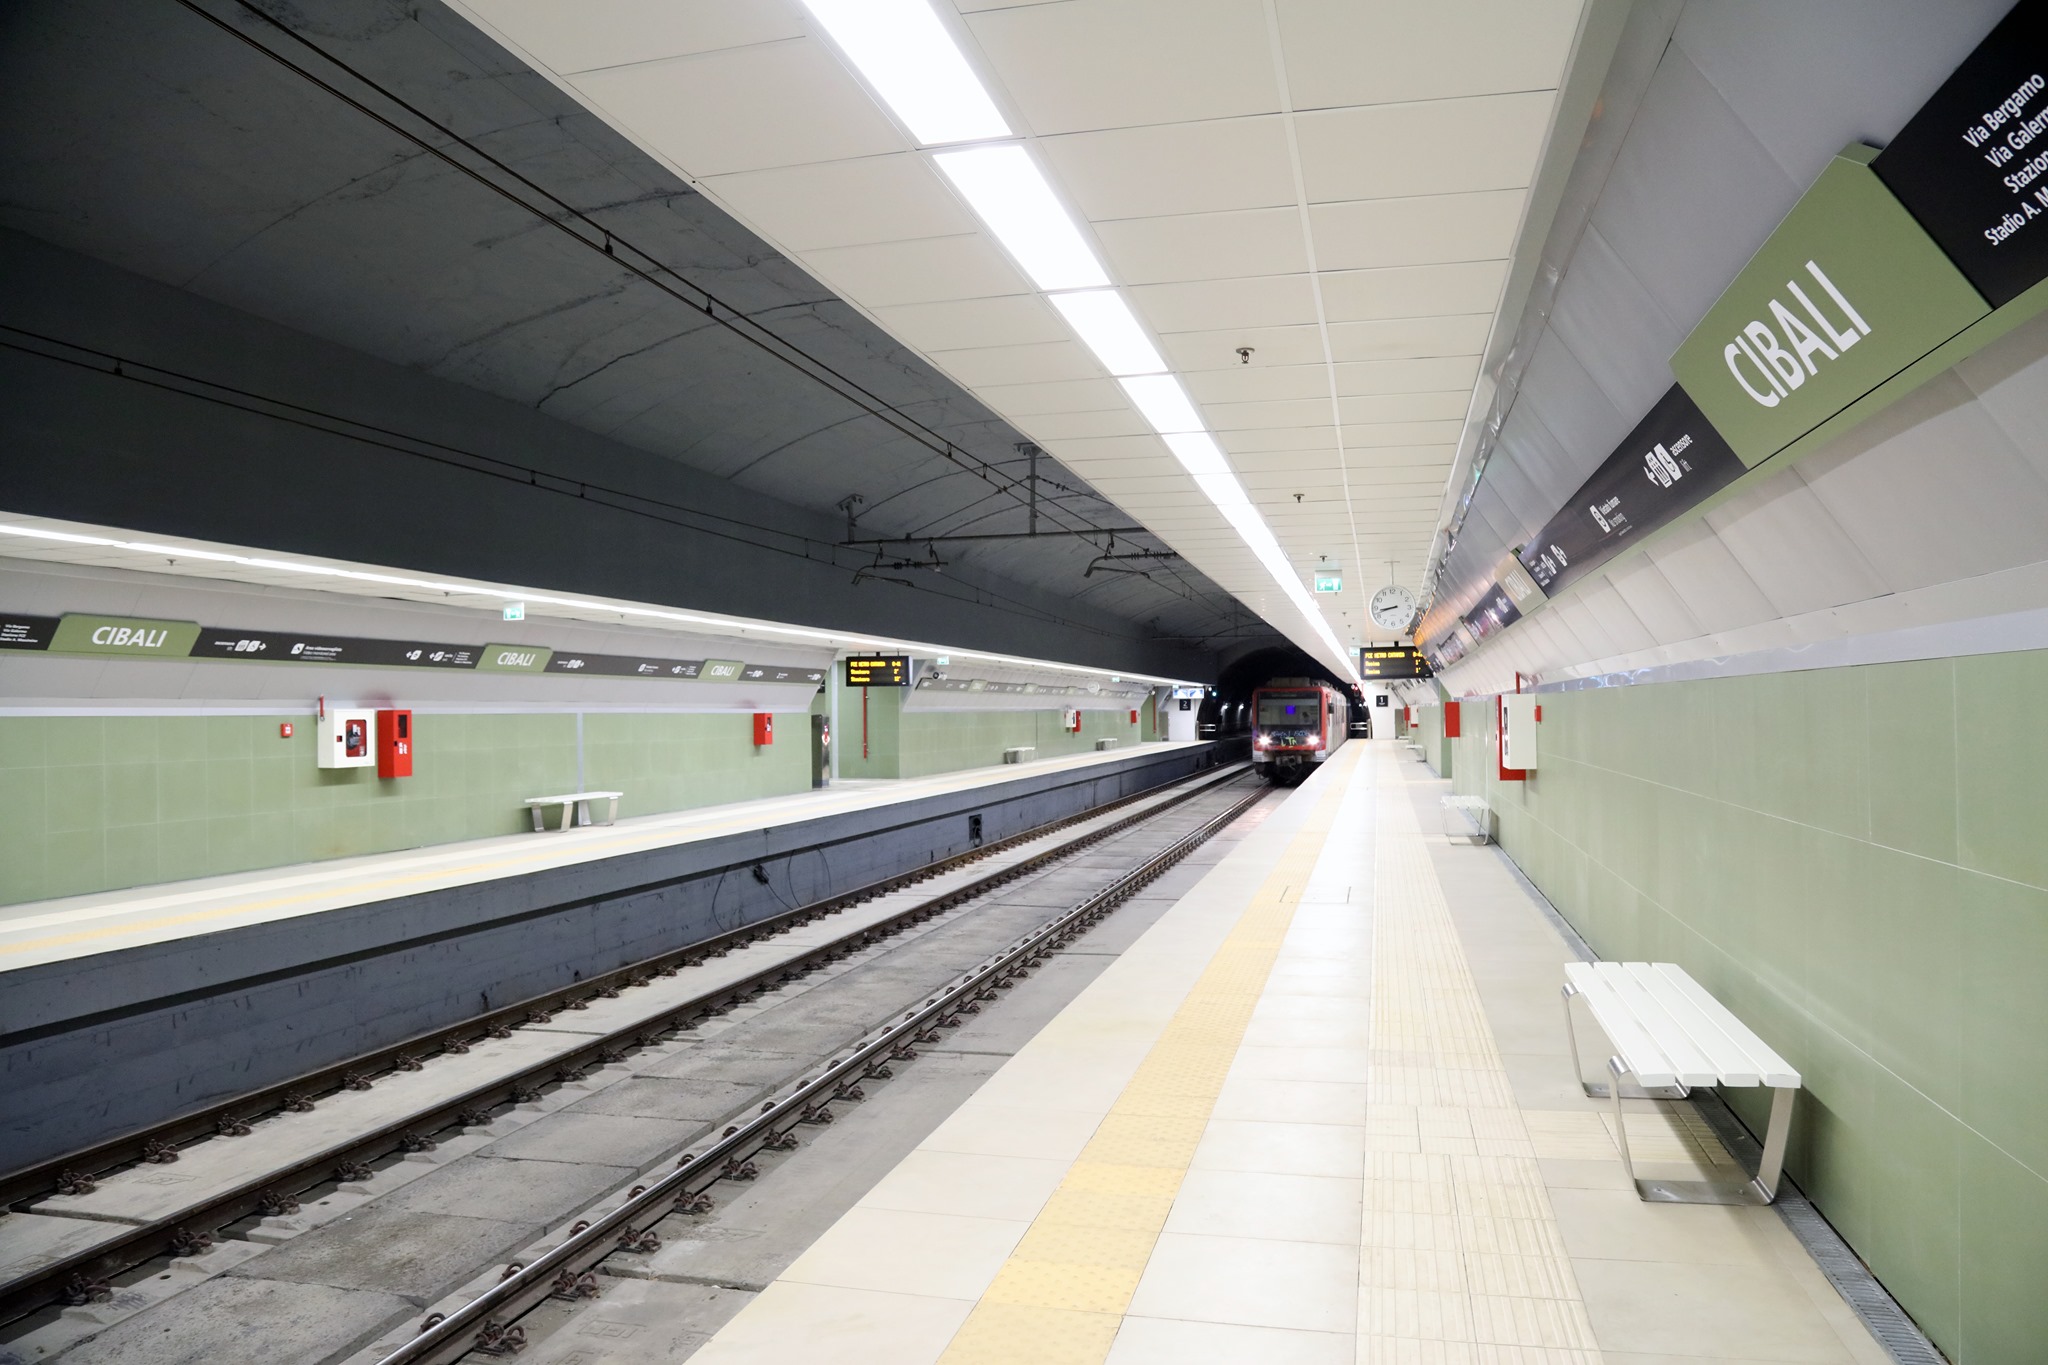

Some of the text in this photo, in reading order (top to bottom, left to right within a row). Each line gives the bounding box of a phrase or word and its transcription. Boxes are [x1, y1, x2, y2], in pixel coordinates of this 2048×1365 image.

[1962, 74, 2045, 148] Via Bergamo
[1984, 146, 2014, 168] Via
[1984, 212, 2026, 246] Stadio
[2021, 201, 2042, 220] A.
[1724, 259, 1872, 408] CIBALI
[91, 626, 168, 648] CIBALI
[497, 651, 537, 667] CIBALI
[710, 665, 735, 676] CIBALI
